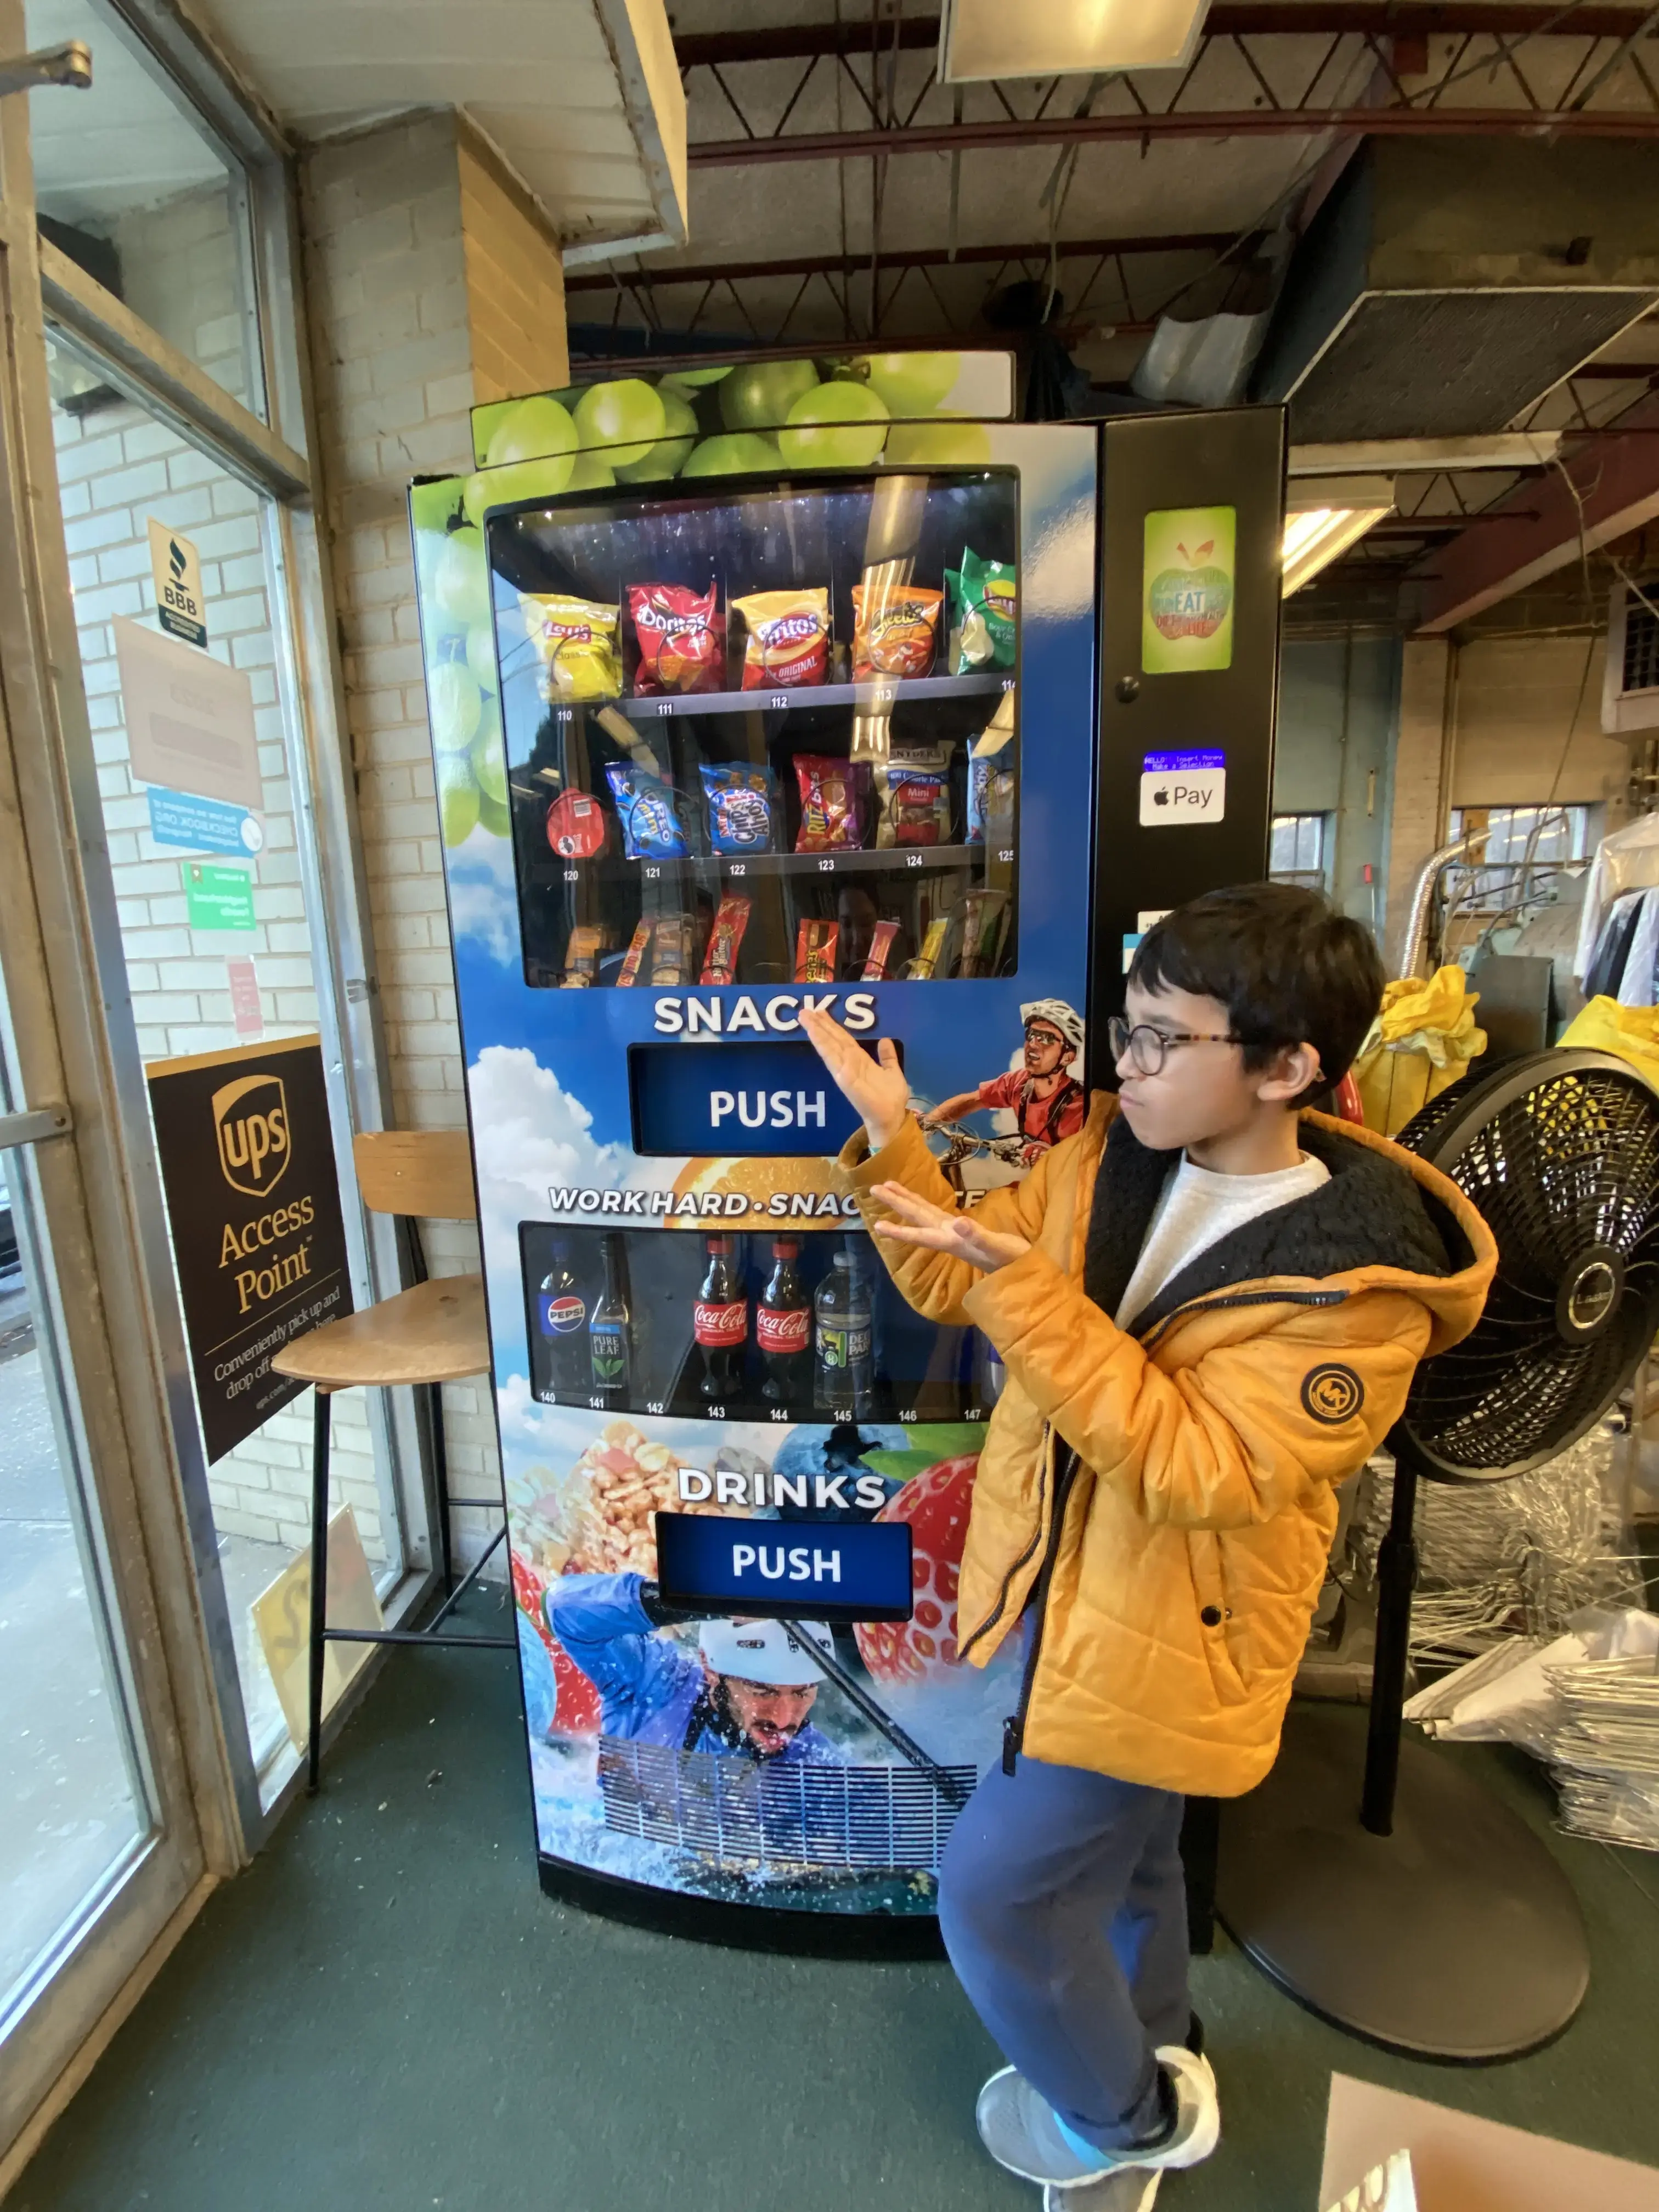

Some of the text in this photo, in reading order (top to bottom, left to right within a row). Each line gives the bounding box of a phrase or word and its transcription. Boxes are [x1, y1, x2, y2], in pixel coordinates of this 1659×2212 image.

[163, 586, 197, 616] BBB
[1175, 591, 1203, 613] EAT
[640, 603, 704, 633] Doritos
[757, 615, 817, 646] Fritos
[778, 656, 817, 678] ORIGINAL
[876, 690, 891, 701] 113
[658, 703, 672, 714] 111
[771, 697, 787, 708] 112
[557, 710, 572, 721] 110
[908, 788, 929, 797] Mini
[1174, 786, 1213, 809] Pay
[642, 792, 671, 843] OREO
[805, 803, 826, 835] RITZ
[906, 855, 923, 866] 124
[998, 850, 1014, 862] 125
[730, 865, 746, 876] 122
[818, 860, 834, 871] 123
[563, 871, 578, 881] 120
[645, 867, 661, 878] 121
[654, 994, 876, 1034] SNACKS
[710, 1091, 826, 1127] PUSH
[223, 1108, 287, 1179] ups
[550, 1187, 861, 1216] WORK HARD SNAC
[219, 1195, 314, 1268] Access
[550, 1308, 583, 1319] PEPSI
[695, 1301, 747, 1329] Coca-Cola
[758, 1309, 808, 1335] Coca-Cola
[215, 1286, 340, 1381] Conveniently pick up and
[593, 1336, 619, 1346] PURE
[595, 1345, 619, 1355] LEAF
[849, 1341, 870, 1355] PAR
[226, 1373, 254, 1400] drop
[255, 1355, 270, 1376] off
[540, 1392, 556, 1403] 140
[589, 1397, 604, 1409] 141
[647, 1403, 663, 1414] 142
[708, 1407, 725, 1418] 143
[771, 1409, 788, 1420] 144
[964, 1409, 980, 1420] 147
[834, 1410, 852, 1421] 145
[899, 1410, 917, 1421] 146
[678, 1468, 887, 1508] DRINKS
[733, 1544, 841, 1583] PUSH
